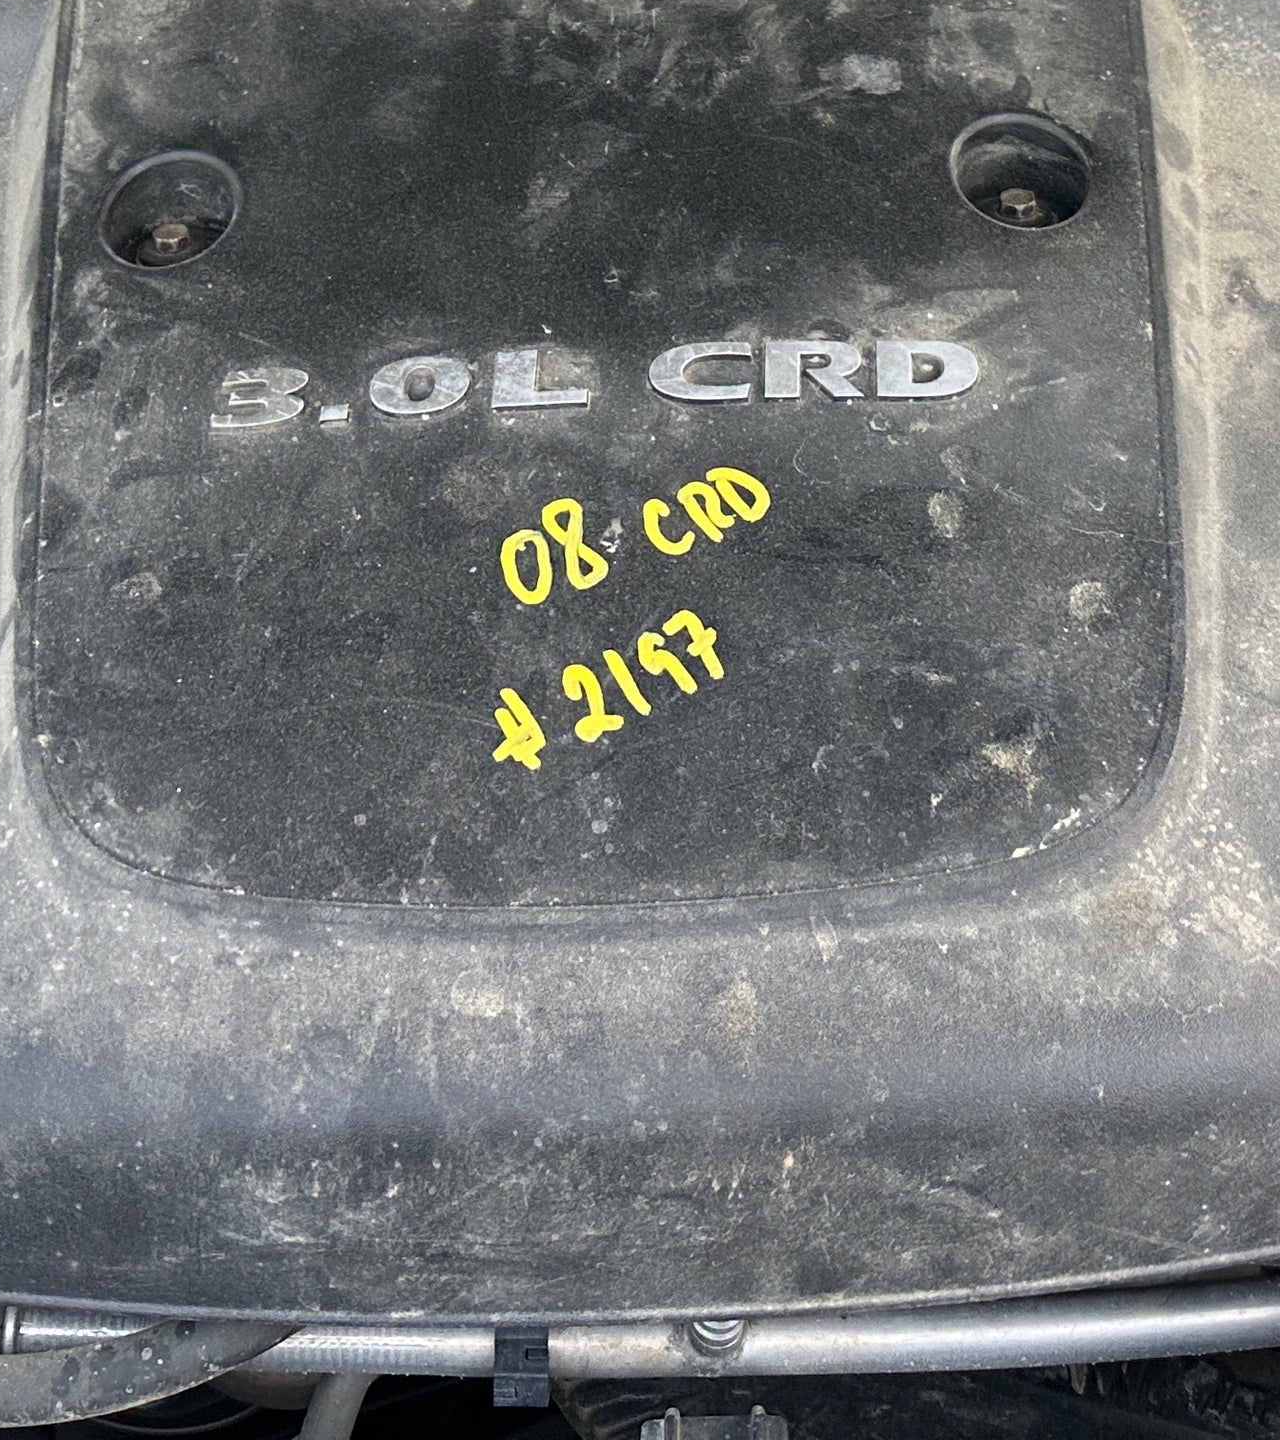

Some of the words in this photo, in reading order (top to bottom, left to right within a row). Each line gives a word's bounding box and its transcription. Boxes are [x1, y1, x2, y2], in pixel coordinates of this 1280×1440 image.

[211, 349, 591, 429] 3.0L
[648, 340, 980, 400] CRD
[500, 497, 609, 605] 08
[643, 466, 772, 556] CRD
